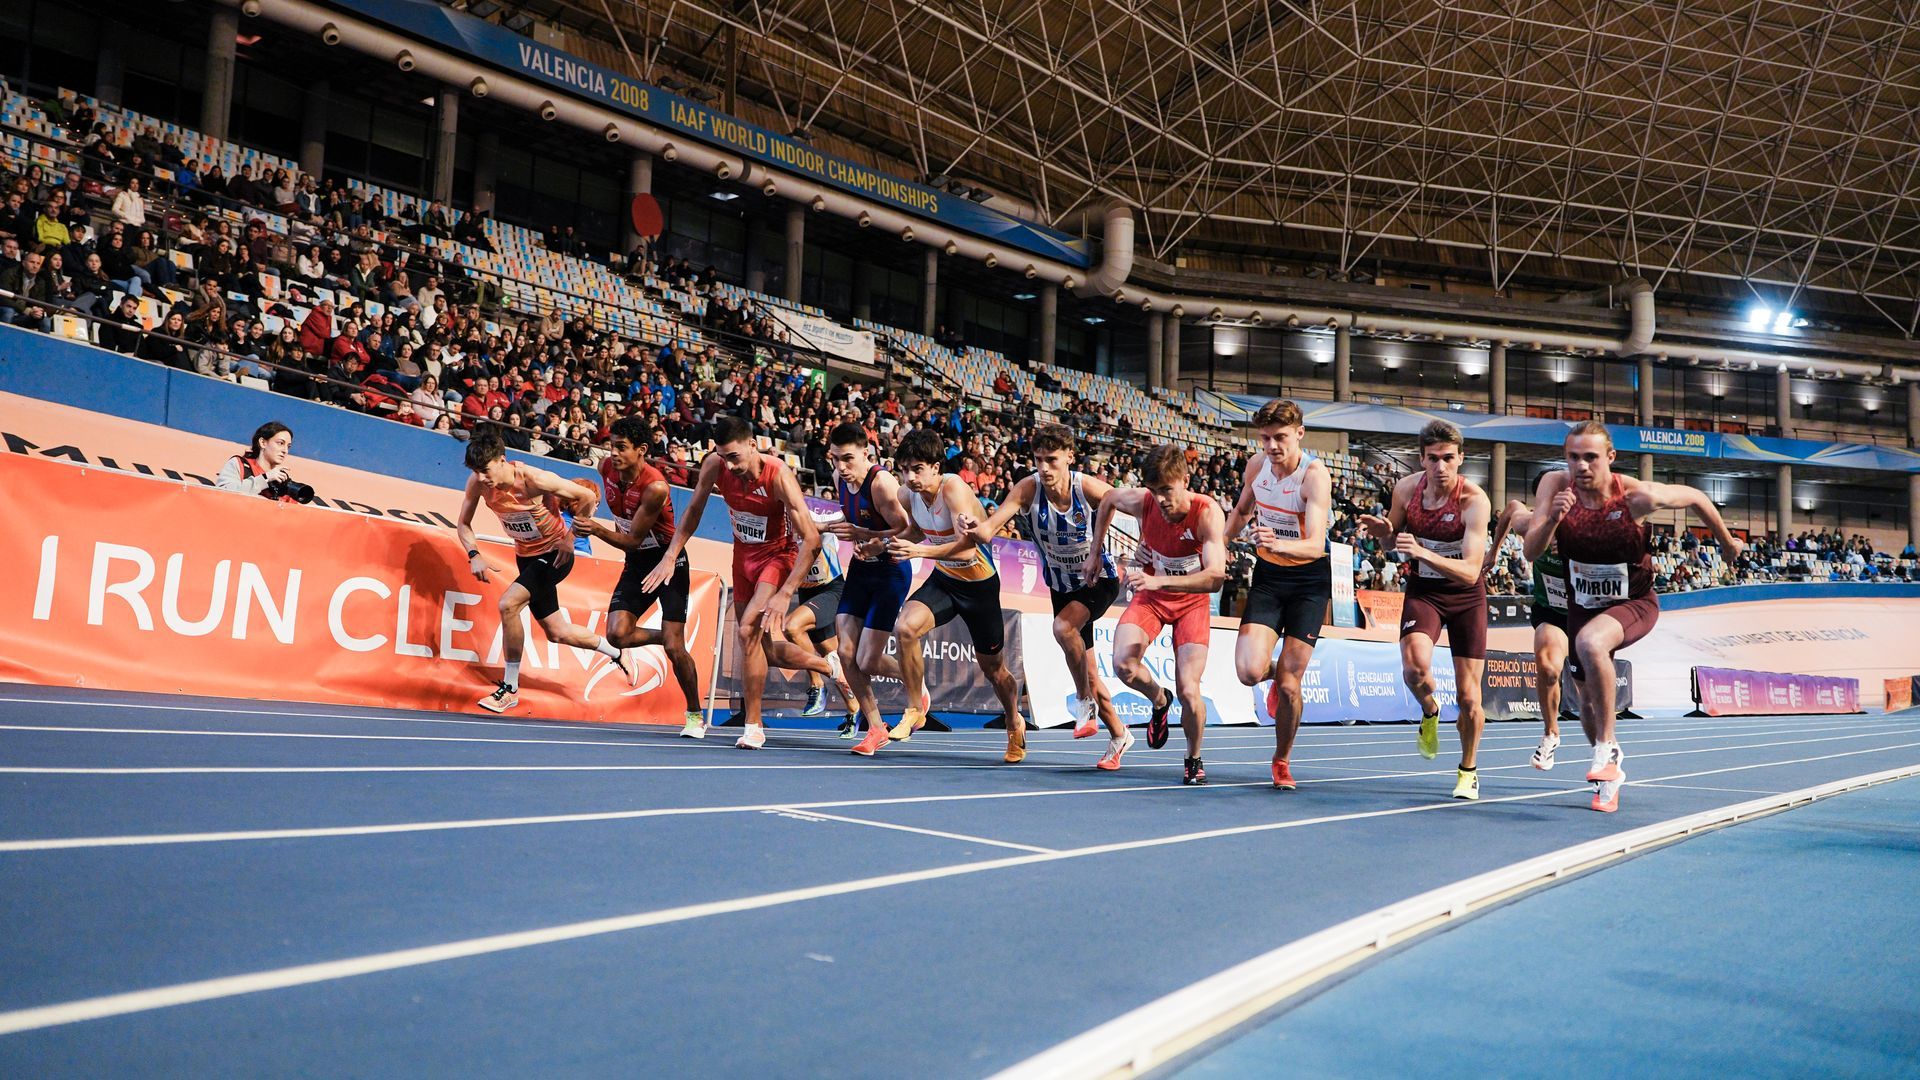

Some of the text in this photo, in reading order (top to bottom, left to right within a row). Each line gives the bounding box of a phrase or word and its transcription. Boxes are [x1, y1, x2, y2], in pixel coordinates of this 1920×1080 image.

[519, 43, 938, 214] VALENCIA 2008 IAAF WORLD INDOOR CHAMPIONSHIPS
[1640, 430, 1705, 446] VALENCIA 2008
[33, 535, 59, 620] I
[87, 541, 302, 645] RUN
[1575, 577, 1622, 596] MIRÓN
[922, 640, 977, 662] ALFONS
[1488, 658, 1538, 674] FEDERACIÓ D'ATL
[1357, 671, 1394, 684] GENERALITAT
[1488, 675, 1537, 689] COMUNITAT VALE
[1358, 684, 1396, 697] VALENCIANA
